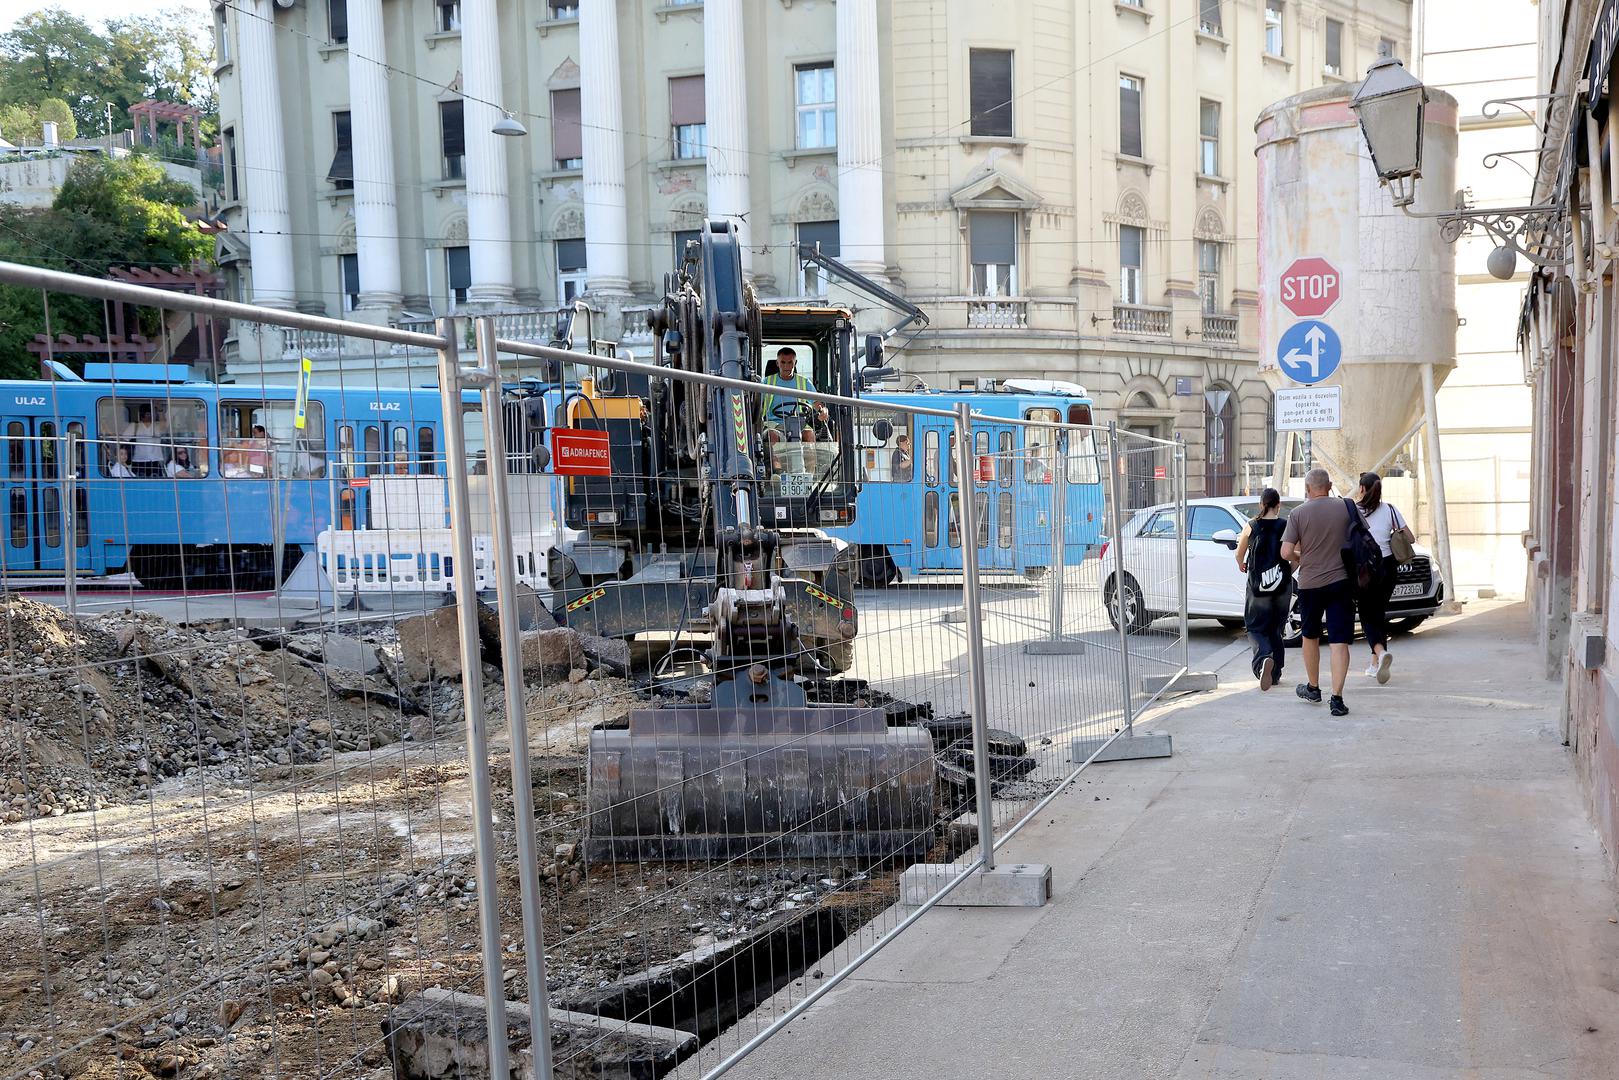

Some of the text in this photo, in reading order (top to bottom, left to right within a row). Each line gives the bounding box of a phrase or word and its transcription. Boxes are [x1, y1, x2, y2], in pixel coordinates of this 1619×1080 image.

[1283, 274, 1336, 301] STOP
[15, 396, 46, 405] ULAZ
[370, 402, 400, 411] IZLAZ
[570, 447, 608, 459] ADRIAFENCE
